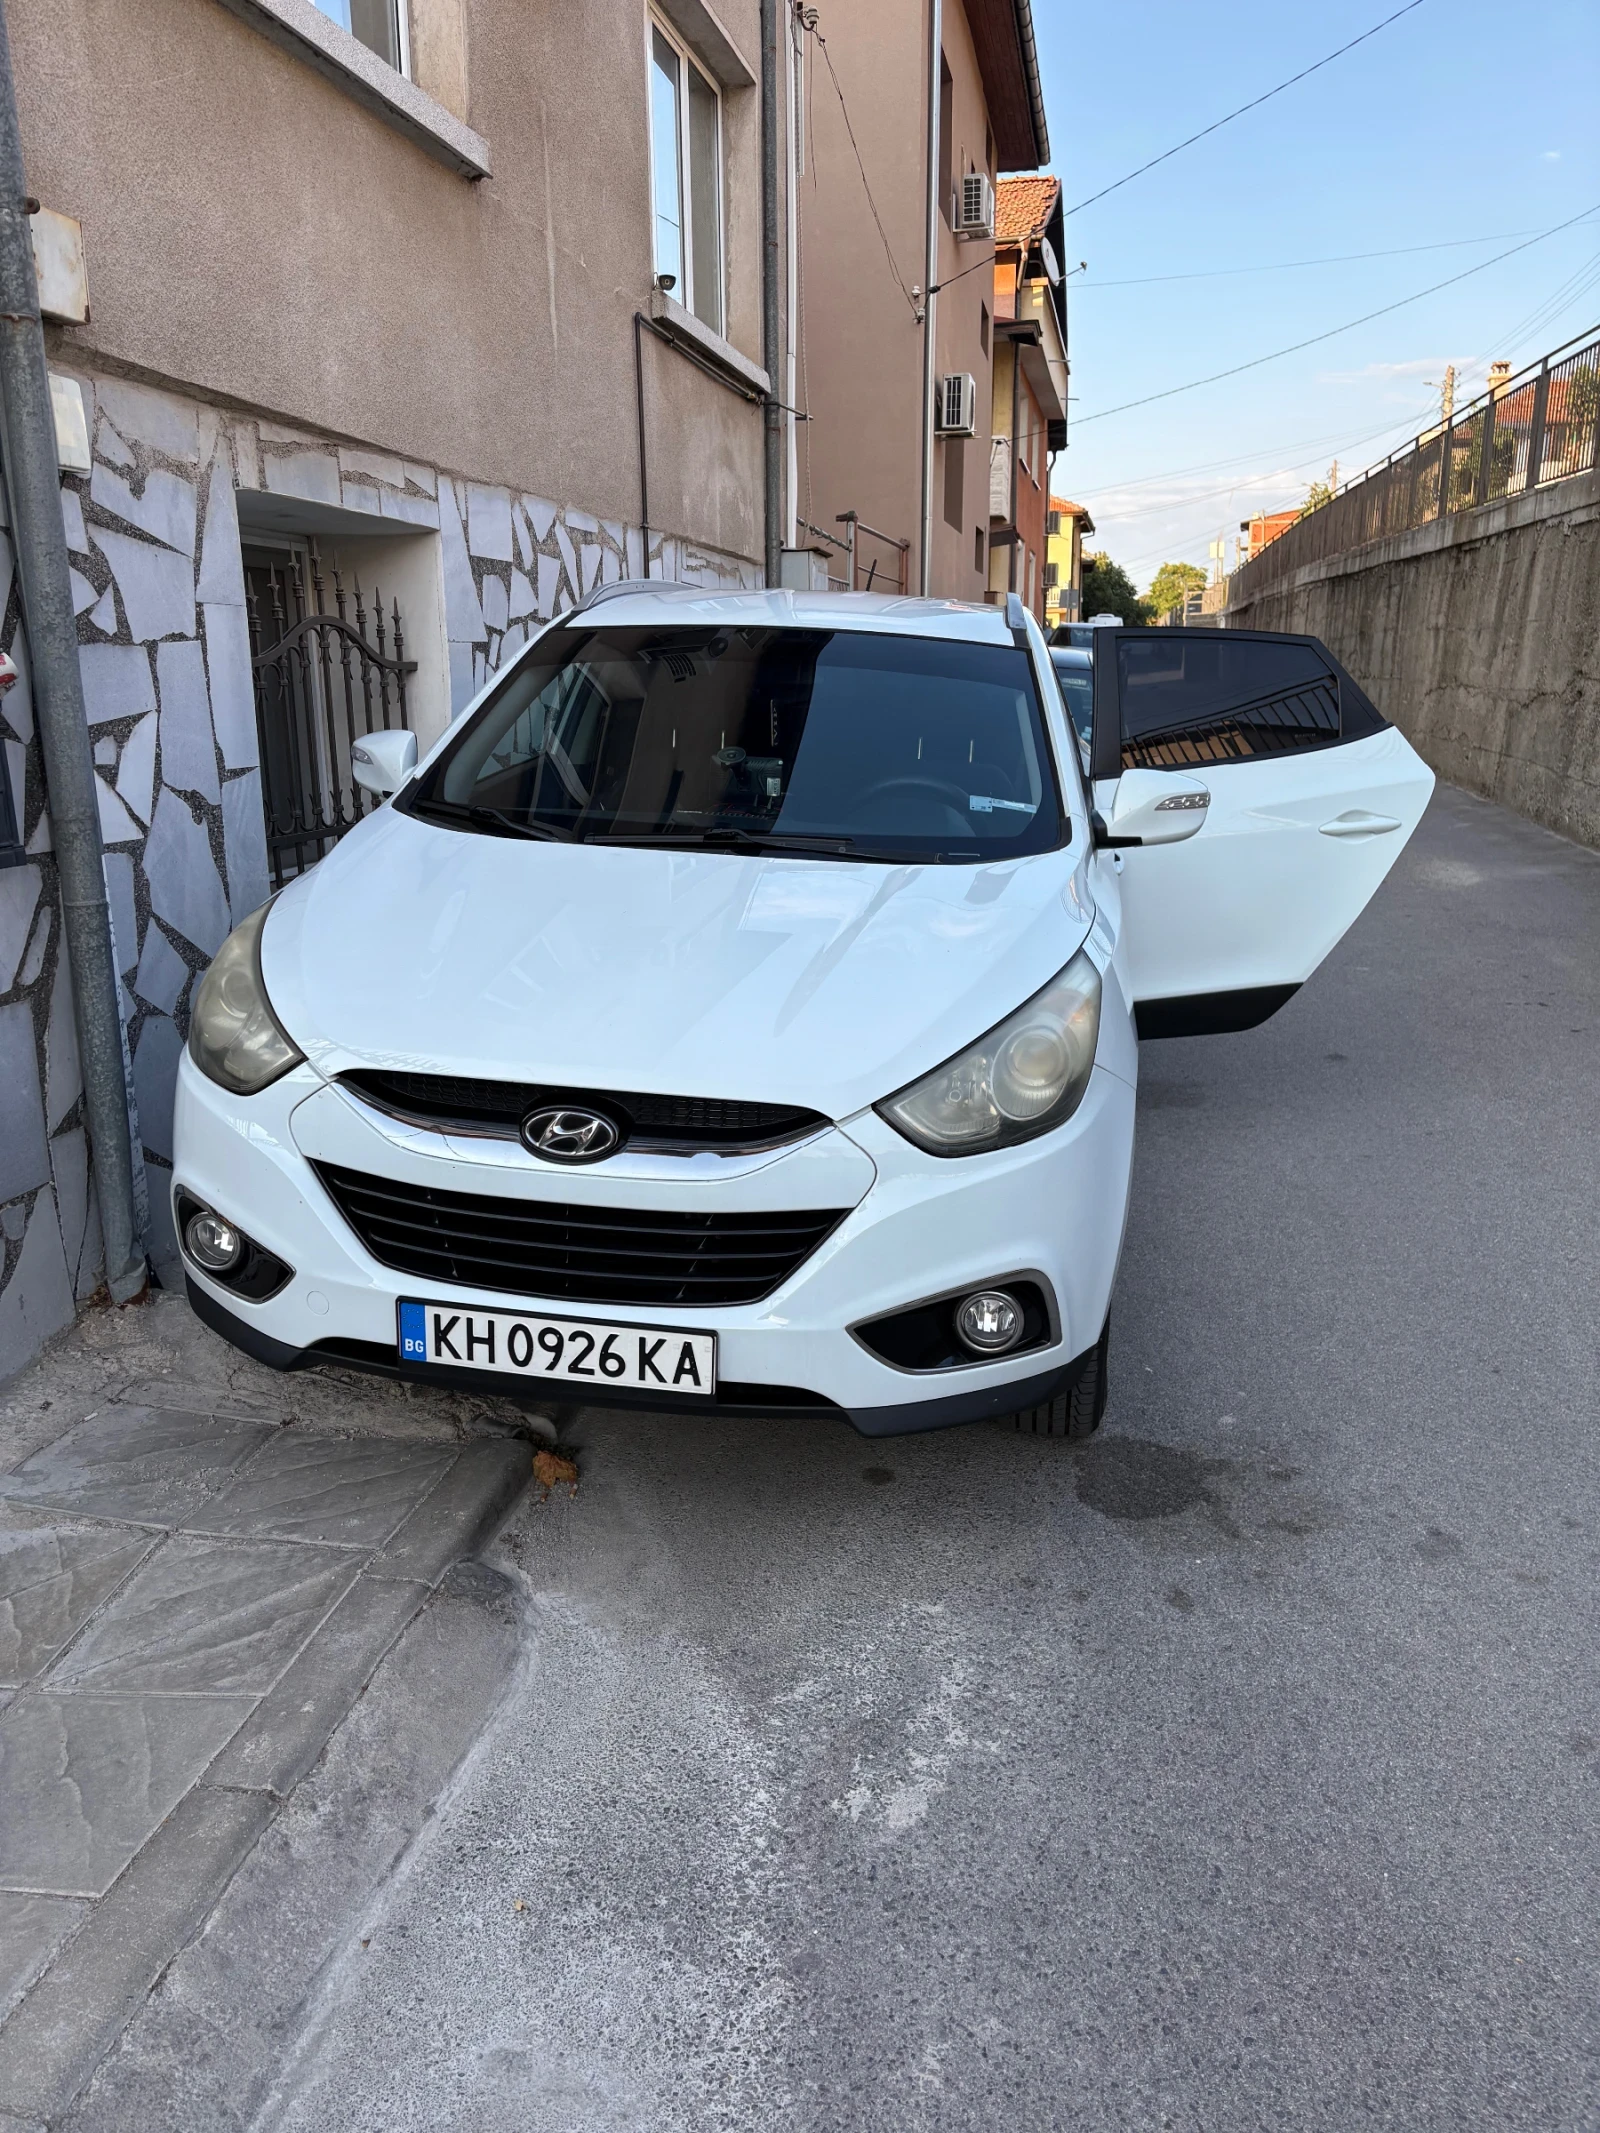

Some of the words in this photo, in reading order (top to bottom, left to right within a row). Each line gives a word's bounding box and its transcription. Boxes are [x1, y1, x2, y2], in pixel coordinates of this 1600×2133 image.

[404, 1338, 424, 1353] BG
[433, 1313, 496, 1364] KH
[507, 1323, 626, 1378] 0926
[638, 1336, 702, 1387] KA
